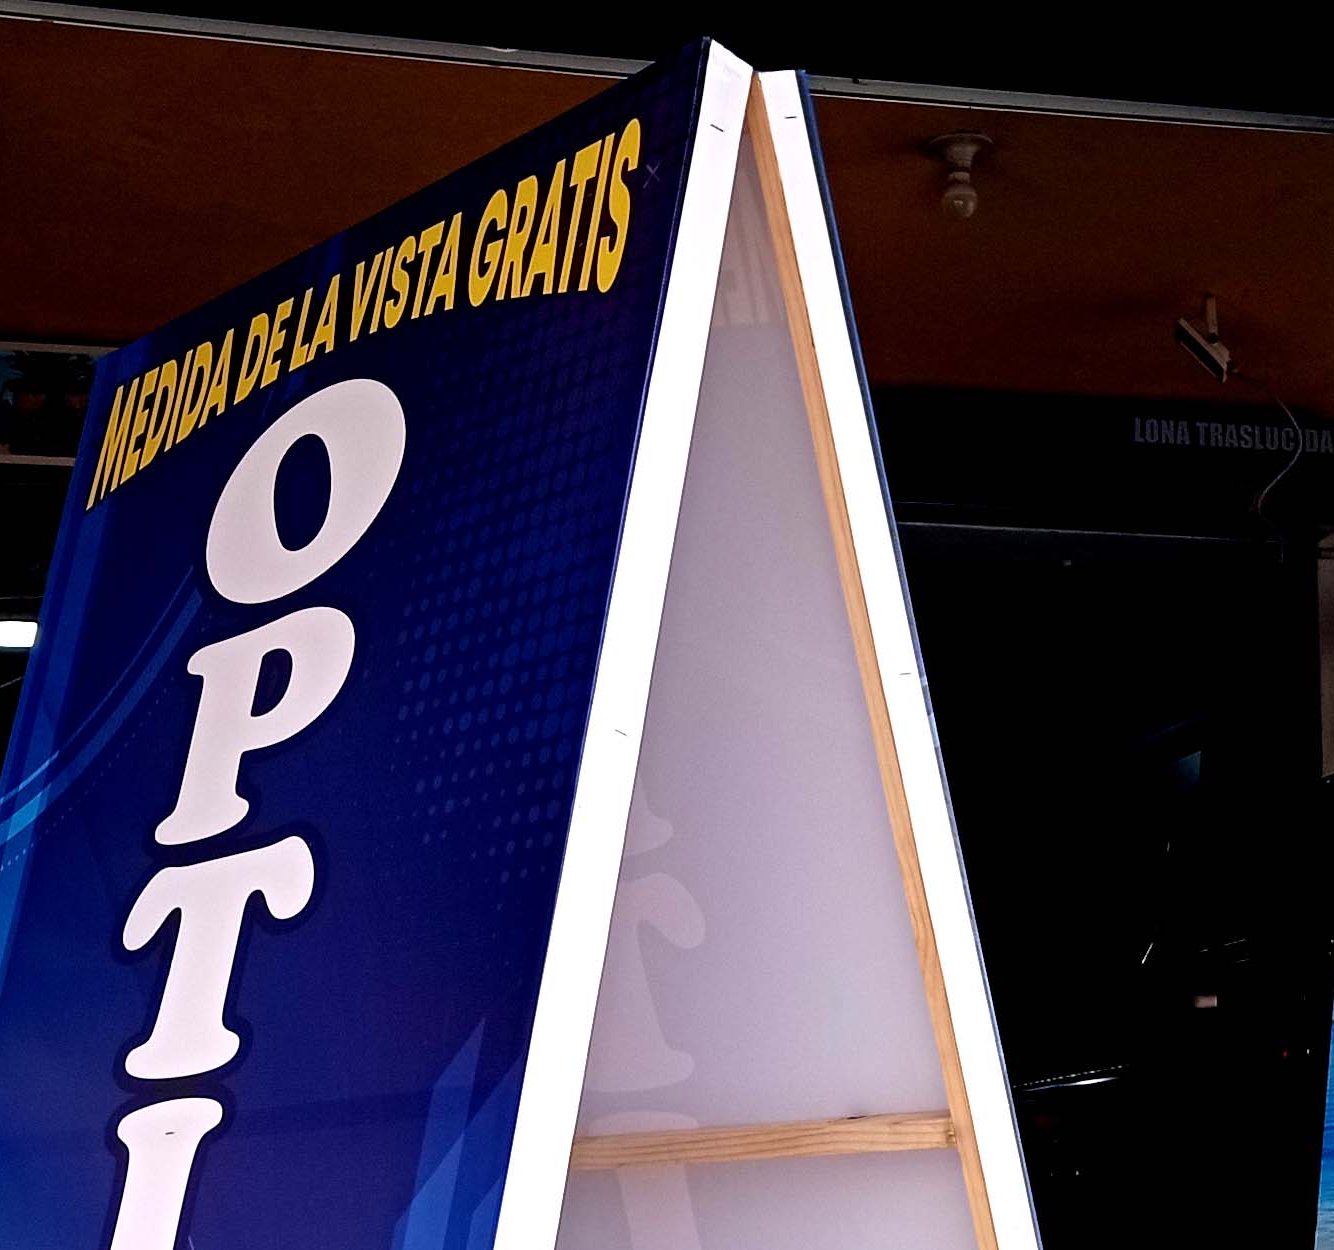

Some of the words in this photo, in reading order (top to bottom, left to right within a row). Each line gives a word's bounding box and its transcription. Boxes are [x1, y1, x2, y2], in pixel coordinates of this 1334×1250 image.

[86, 329, 234, 510] MEDIDA
[233, 297, 295, 405] DE
[288, 273, 338, 371] LA
[349, 211, 463, 341] VISTA
[468, 118, 641, 307] GRATIS
[1133, 415, 1192, 445] LONA
[1195, 421, 1334, 455] TRASLUCDA
